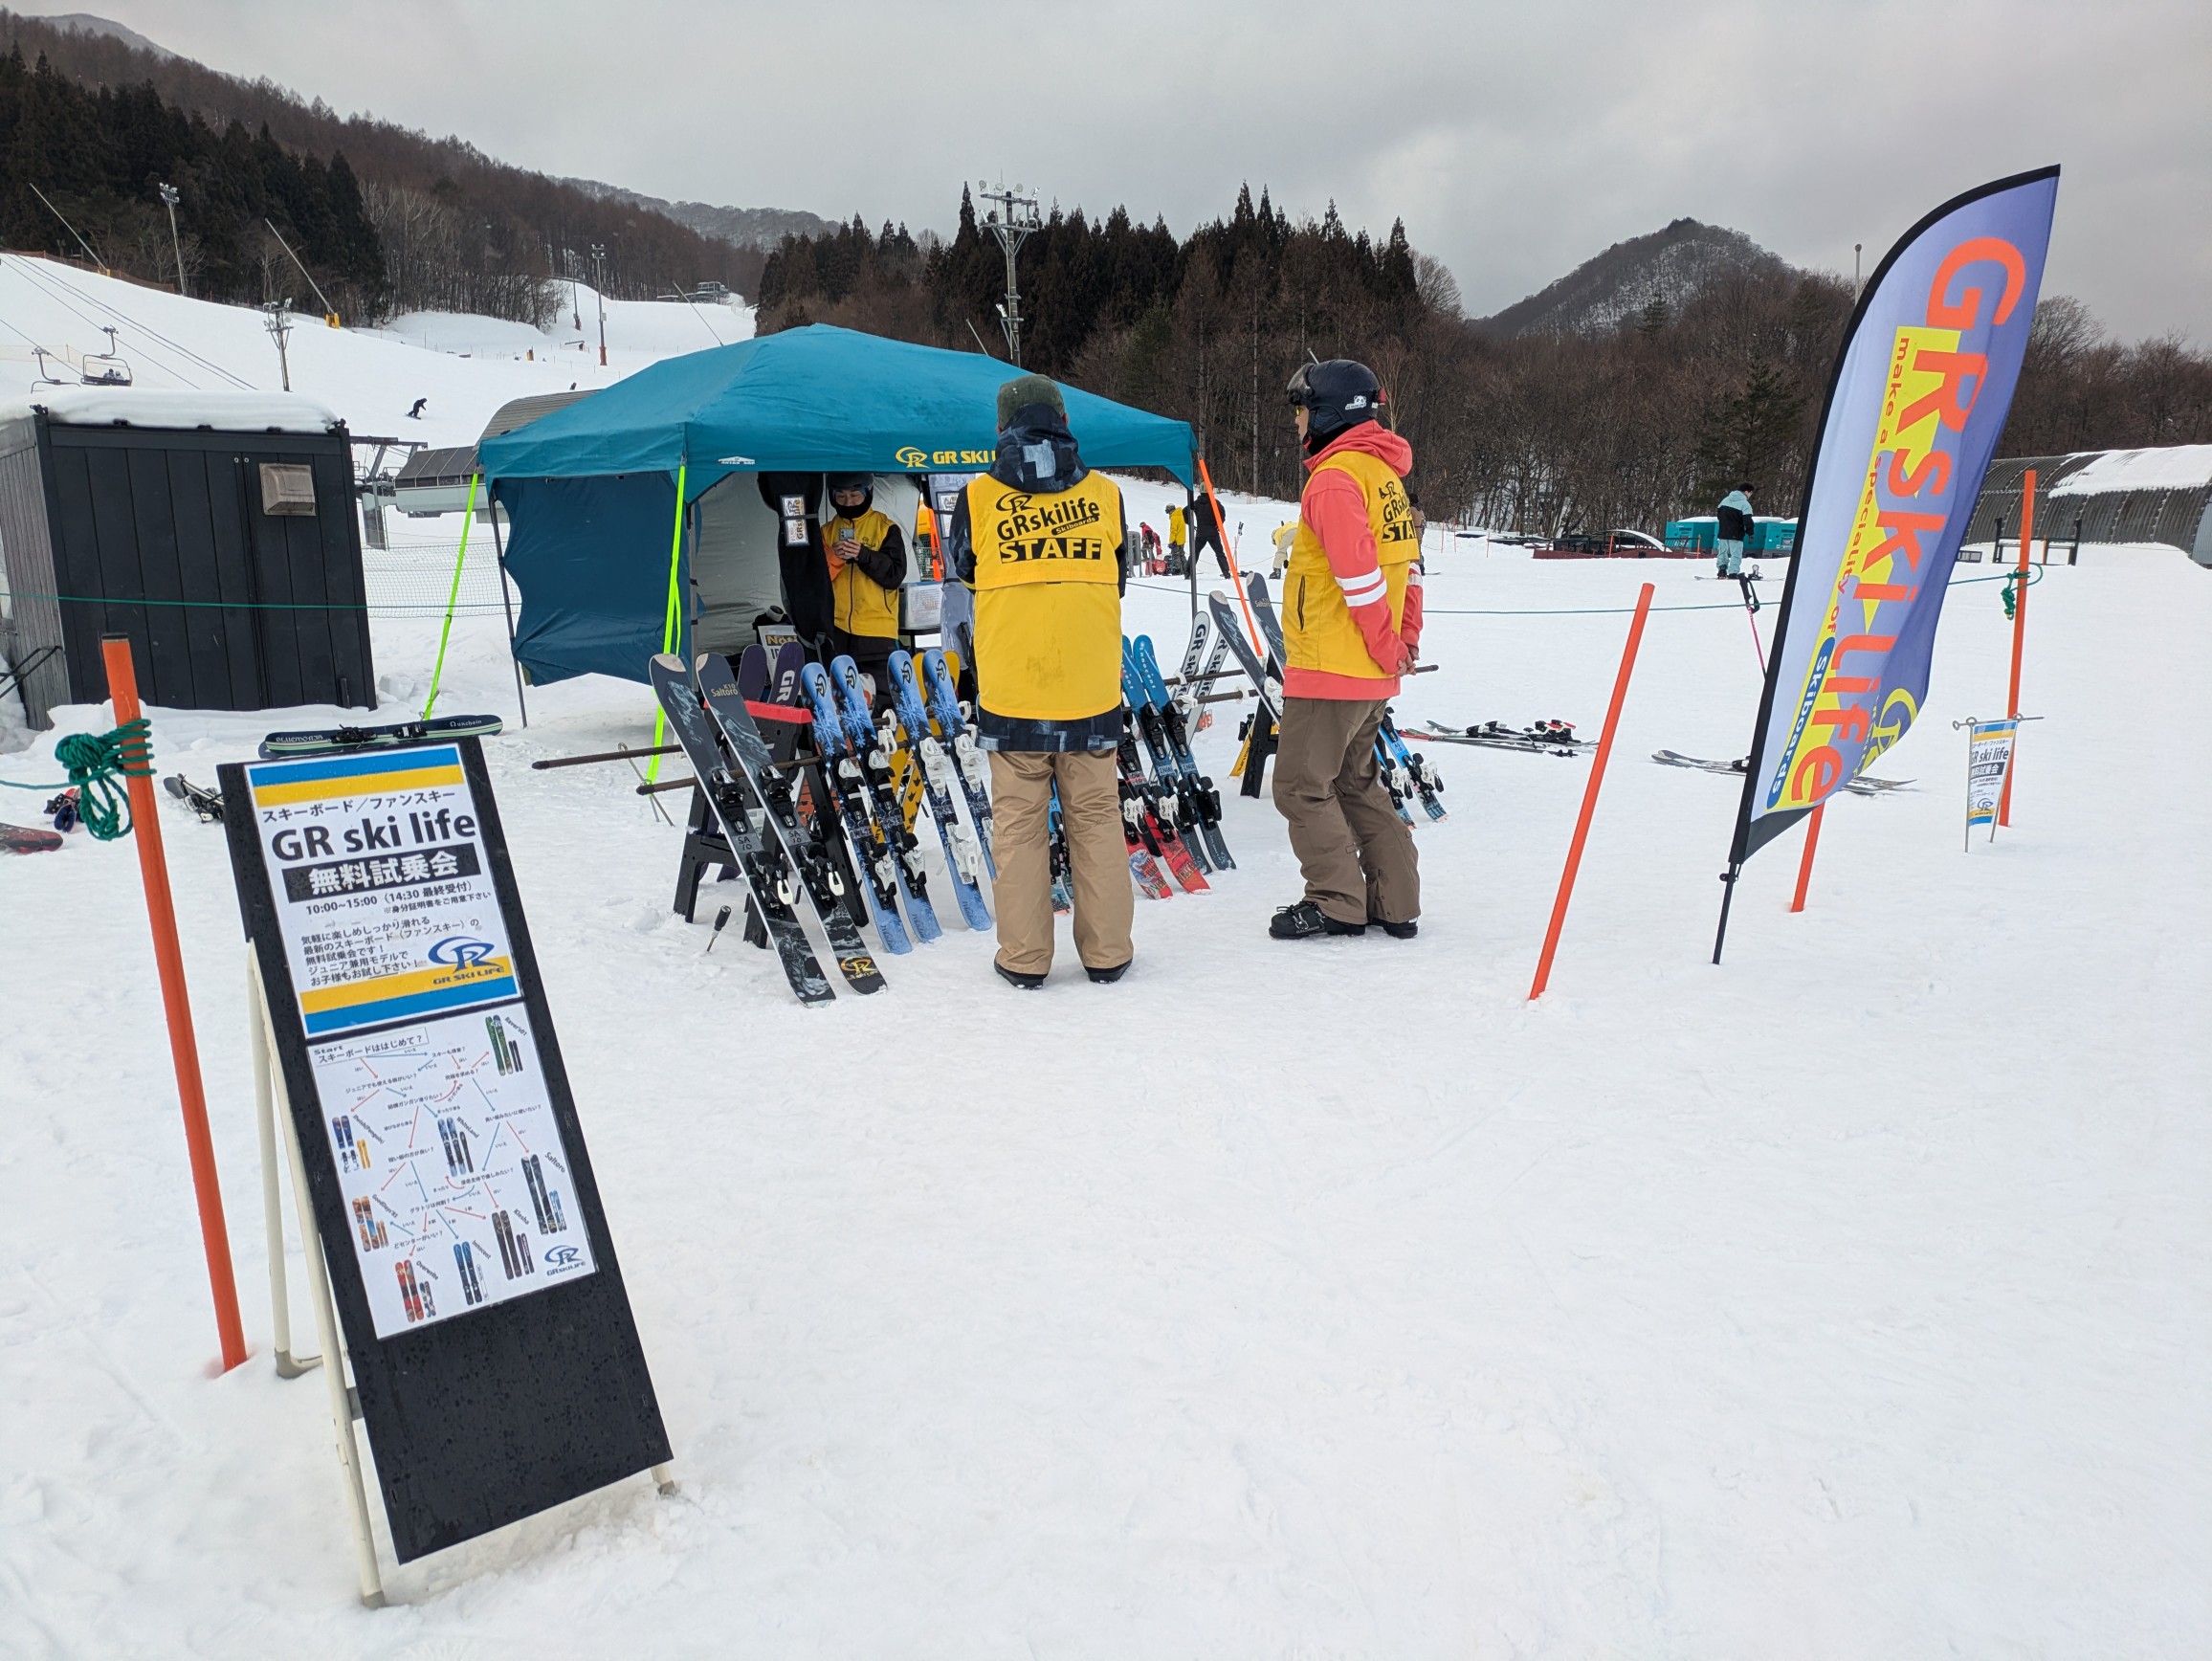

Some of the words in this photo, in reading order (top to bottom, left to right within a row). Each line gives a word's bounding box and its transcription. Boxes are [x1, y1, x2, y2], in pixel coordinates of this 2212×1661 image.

[1885, 338, 1910, 417] make
[1880, 429, 1888, 444] a
[933, 450, 959, 464] GR
[961, 449, 989, 464] SKI
[997, 498, 1100, 541] GRskilife
[999, 539, 1101, 563] STAFF
[1827, 605, 1840, 632] of
[1191, 624, 1206, 651] GR
[711, 688, 739, 698] Saltoro
[1772, 654, 1827, 793] Skiboards
[1980, 748, 1991, 762] ski
[1993, 746, 2009, 761] life
[269, 824, 335, 863] GR
[341, 814, 401, 853] ski
[409, 805, 477, 844] life
[307, 848, 459, 896] 無料試乗会
[432, 976, 451, 985] GR
[453, 971, 476, 981] SKI
[477, 965, 504, 976] LIFE
[544, 1152, 565, 1173] Saltoro
